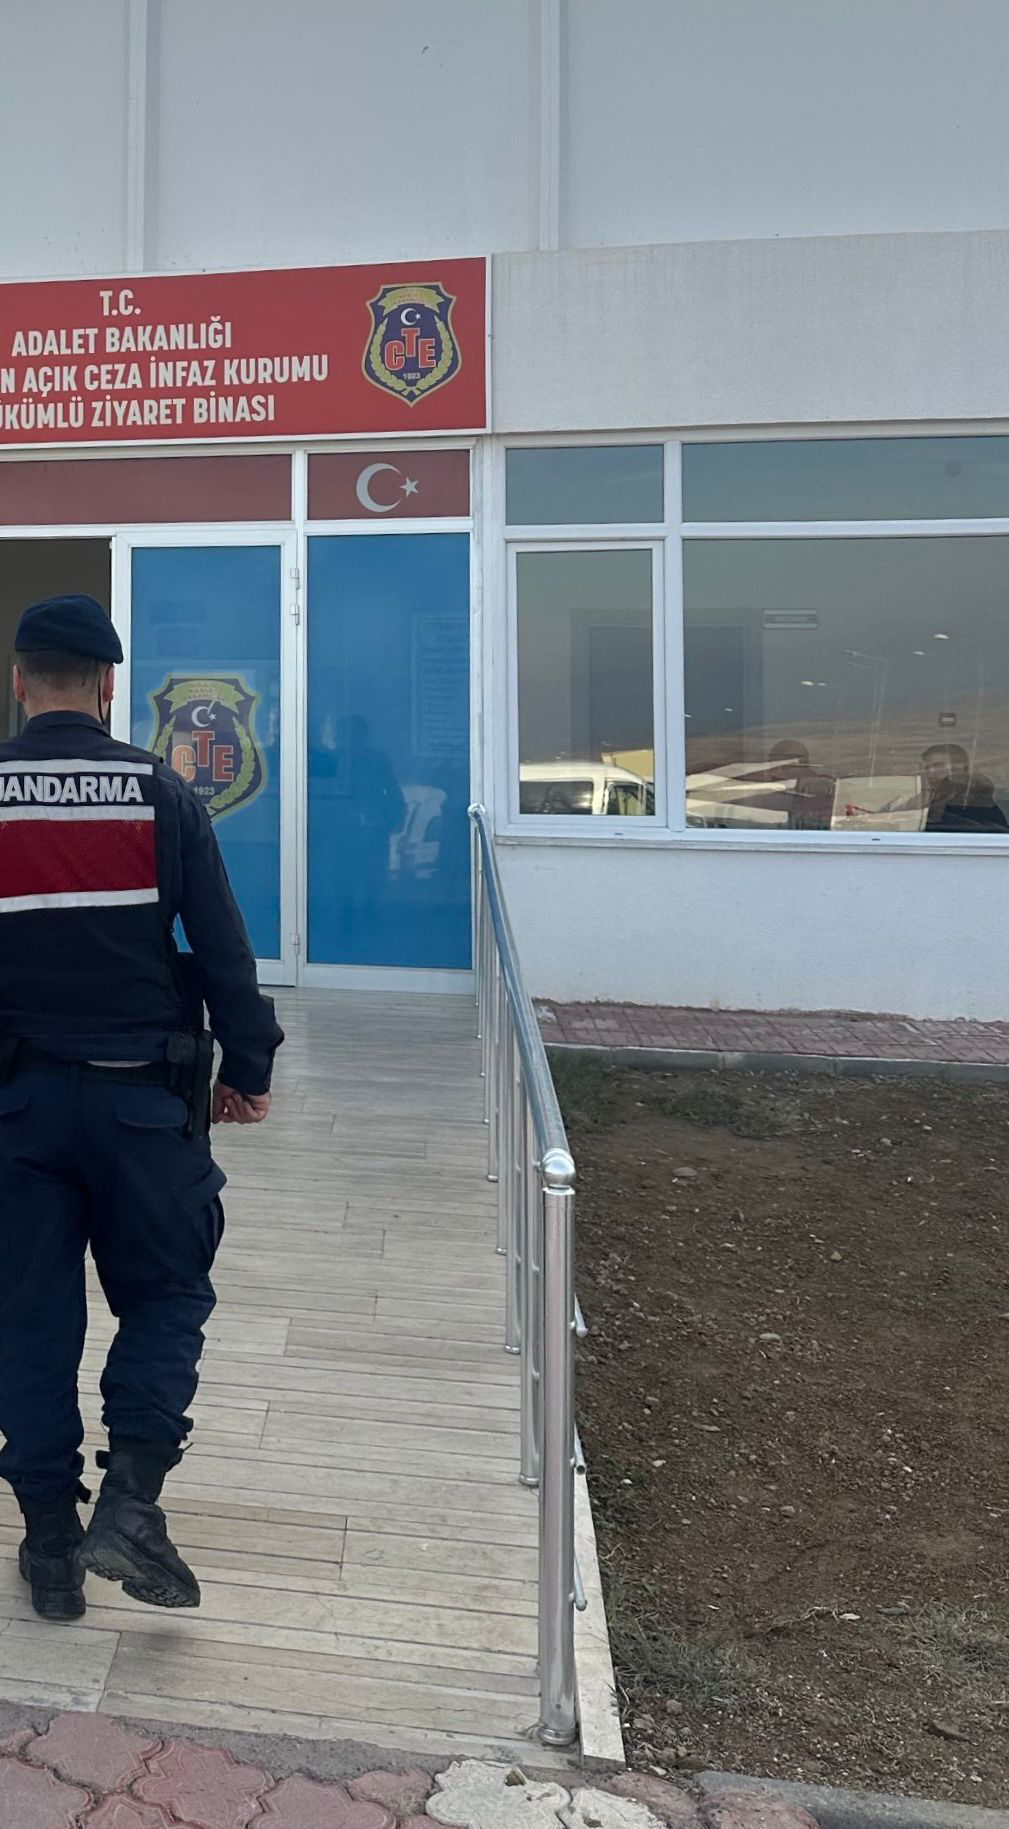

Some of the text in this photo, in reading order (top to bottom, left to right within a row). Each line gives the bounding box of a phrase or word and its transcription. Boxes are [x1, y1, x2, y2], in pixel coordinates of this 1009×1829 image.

[99, 289, 141, 316] T.C.
[11, 315, 232, 357] ADALET BAKANLIĞI
[22, 365, 78, 398] AÇIK
[84, 363, 143, 391] CEZA
[149, 356, 217, 389] İNFAZ
[223, 354, 329, 386] KURUMU
[91, 394, 186, 428] ZİYARET
[193, 391, 276, 425] BİNASI
